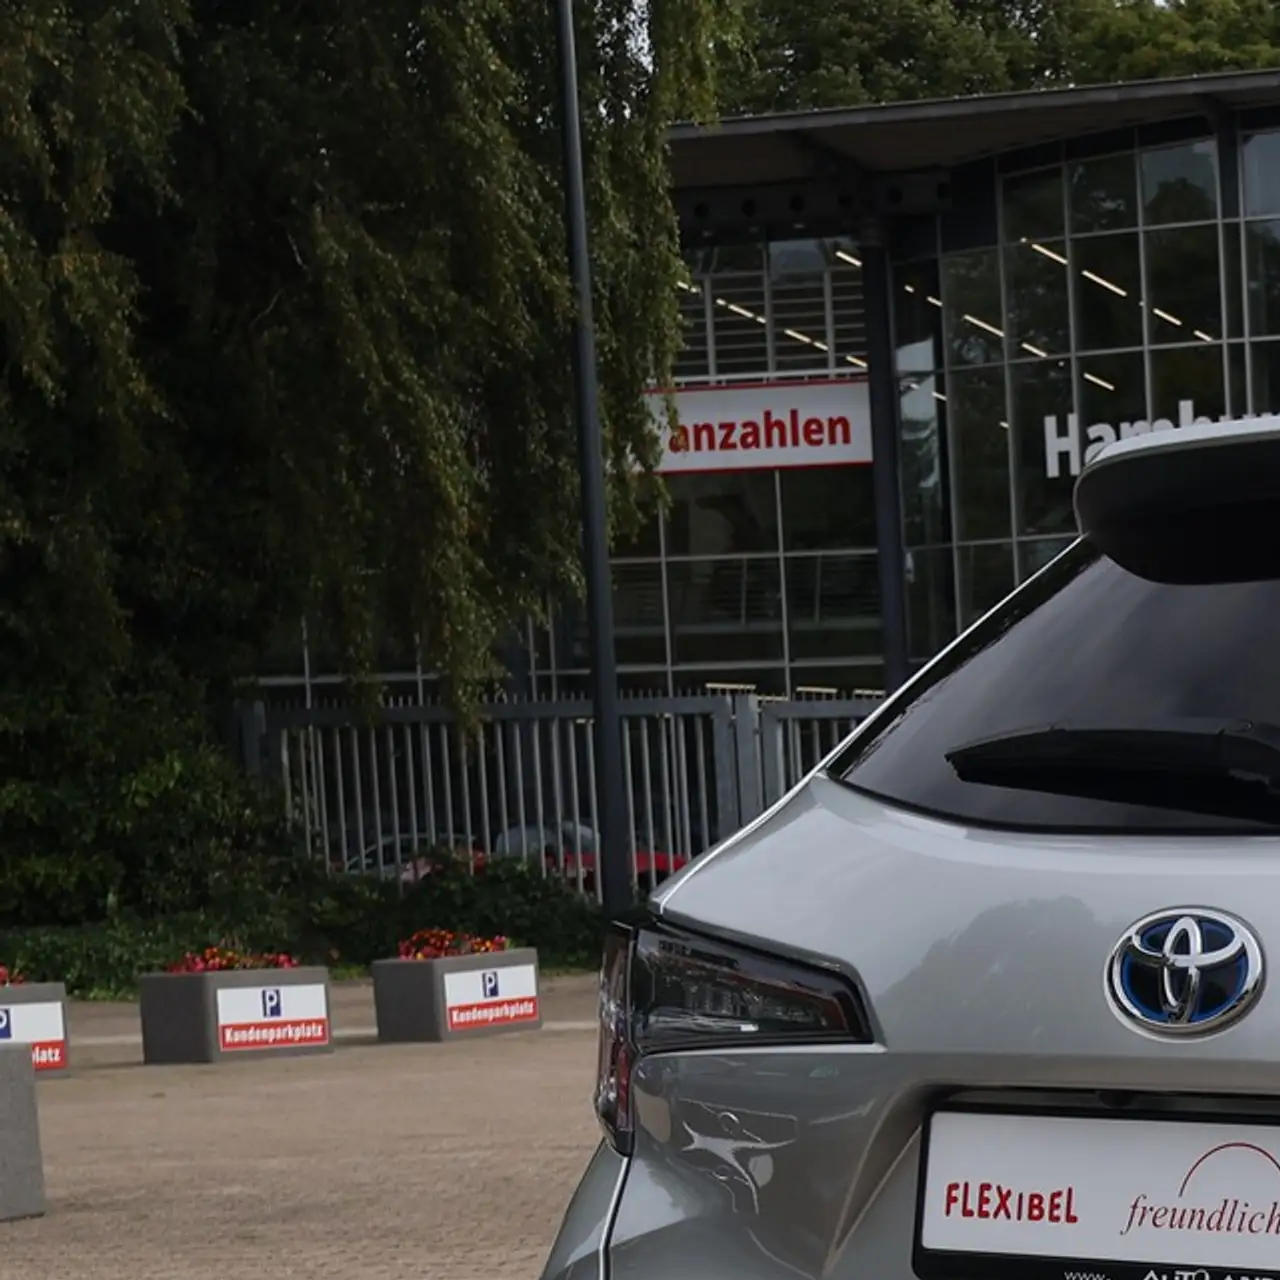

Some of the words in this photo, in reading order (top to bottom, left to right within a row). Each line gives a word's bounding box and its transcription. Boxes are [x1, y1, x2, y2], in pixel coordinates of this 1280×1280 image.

[668, 408, 852, 454] anzahlen
[451, 1001, 535, 1024] Kundenparkplatz
[224, 1022, 324, 1045] Kundenparkplatz
[944, 1181, 1079, 1225] FLEXIBEL
